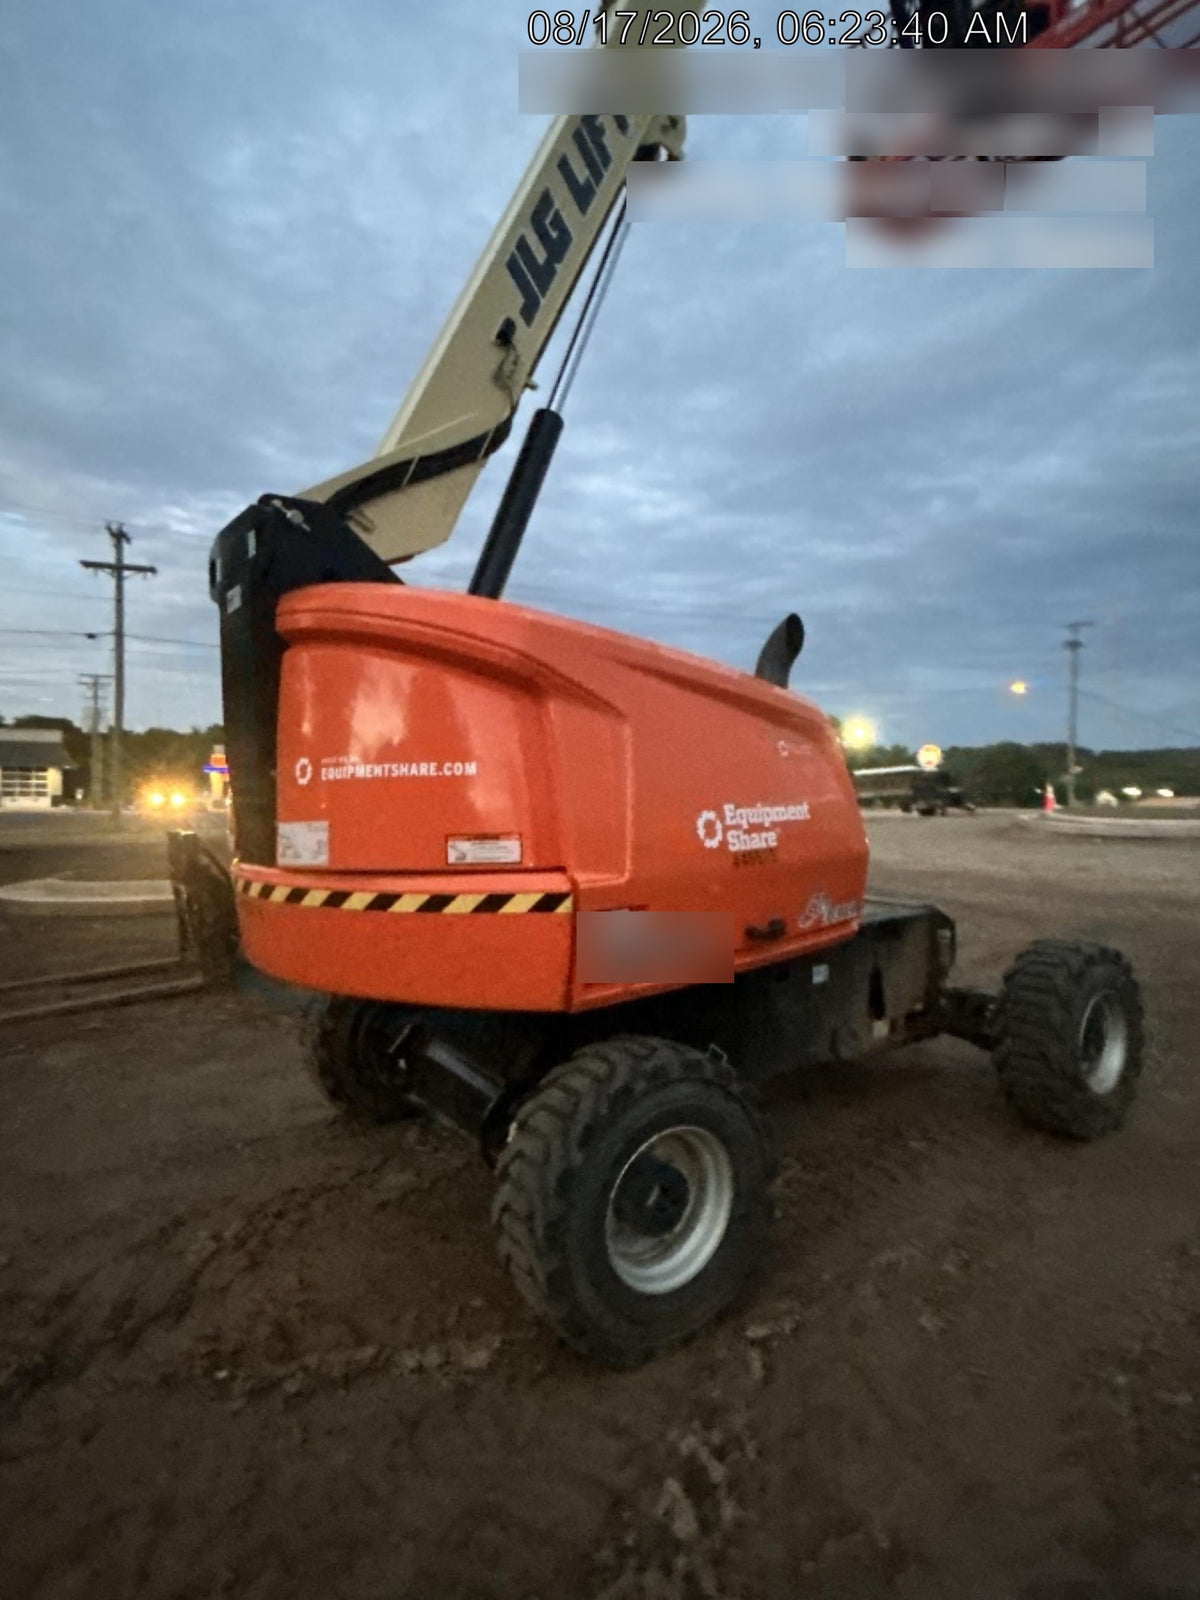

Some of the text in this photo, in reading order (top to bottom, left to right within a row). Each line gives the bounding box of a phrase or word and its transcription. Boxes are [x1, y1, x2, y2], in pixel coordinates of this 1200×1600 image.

[505, 187, 573, 328] JLG
[320, 761, 478, 781] EQUIPMENTSHARE.COM
[722, 802, 811, 829] Equipment
[726, 829, 779, 852] Share
